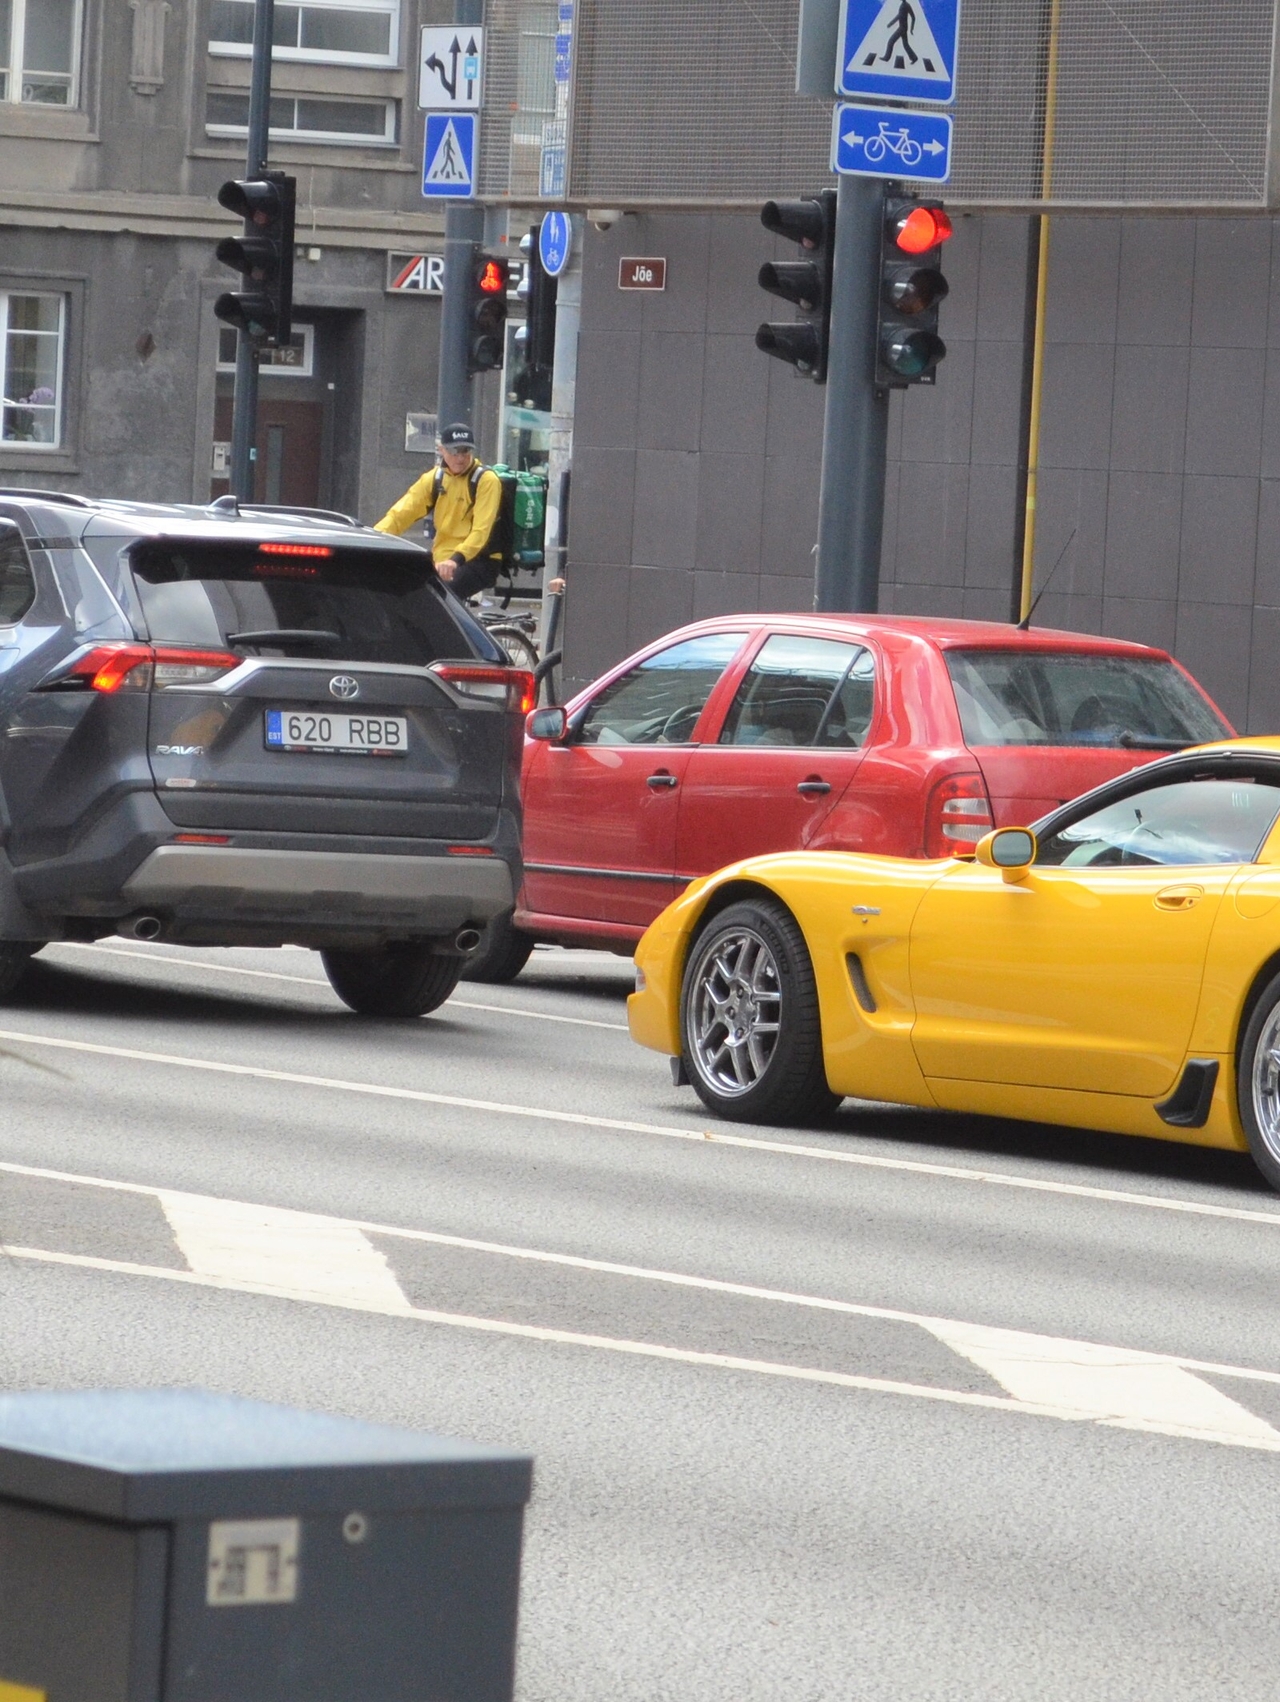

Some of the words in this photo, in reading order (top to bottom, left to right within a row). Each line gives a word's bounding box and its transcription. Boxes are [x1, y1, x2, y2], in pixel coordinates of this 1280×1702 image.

[632, 265, 653, 283] Jõe
[280, 349, 295, 362] 12
[268, 731, 281, 740] EST
[288, 715, 332, 742] 620
[348, 718, 400, 746] RBB
[155, 744, 204, 756] RAV4
